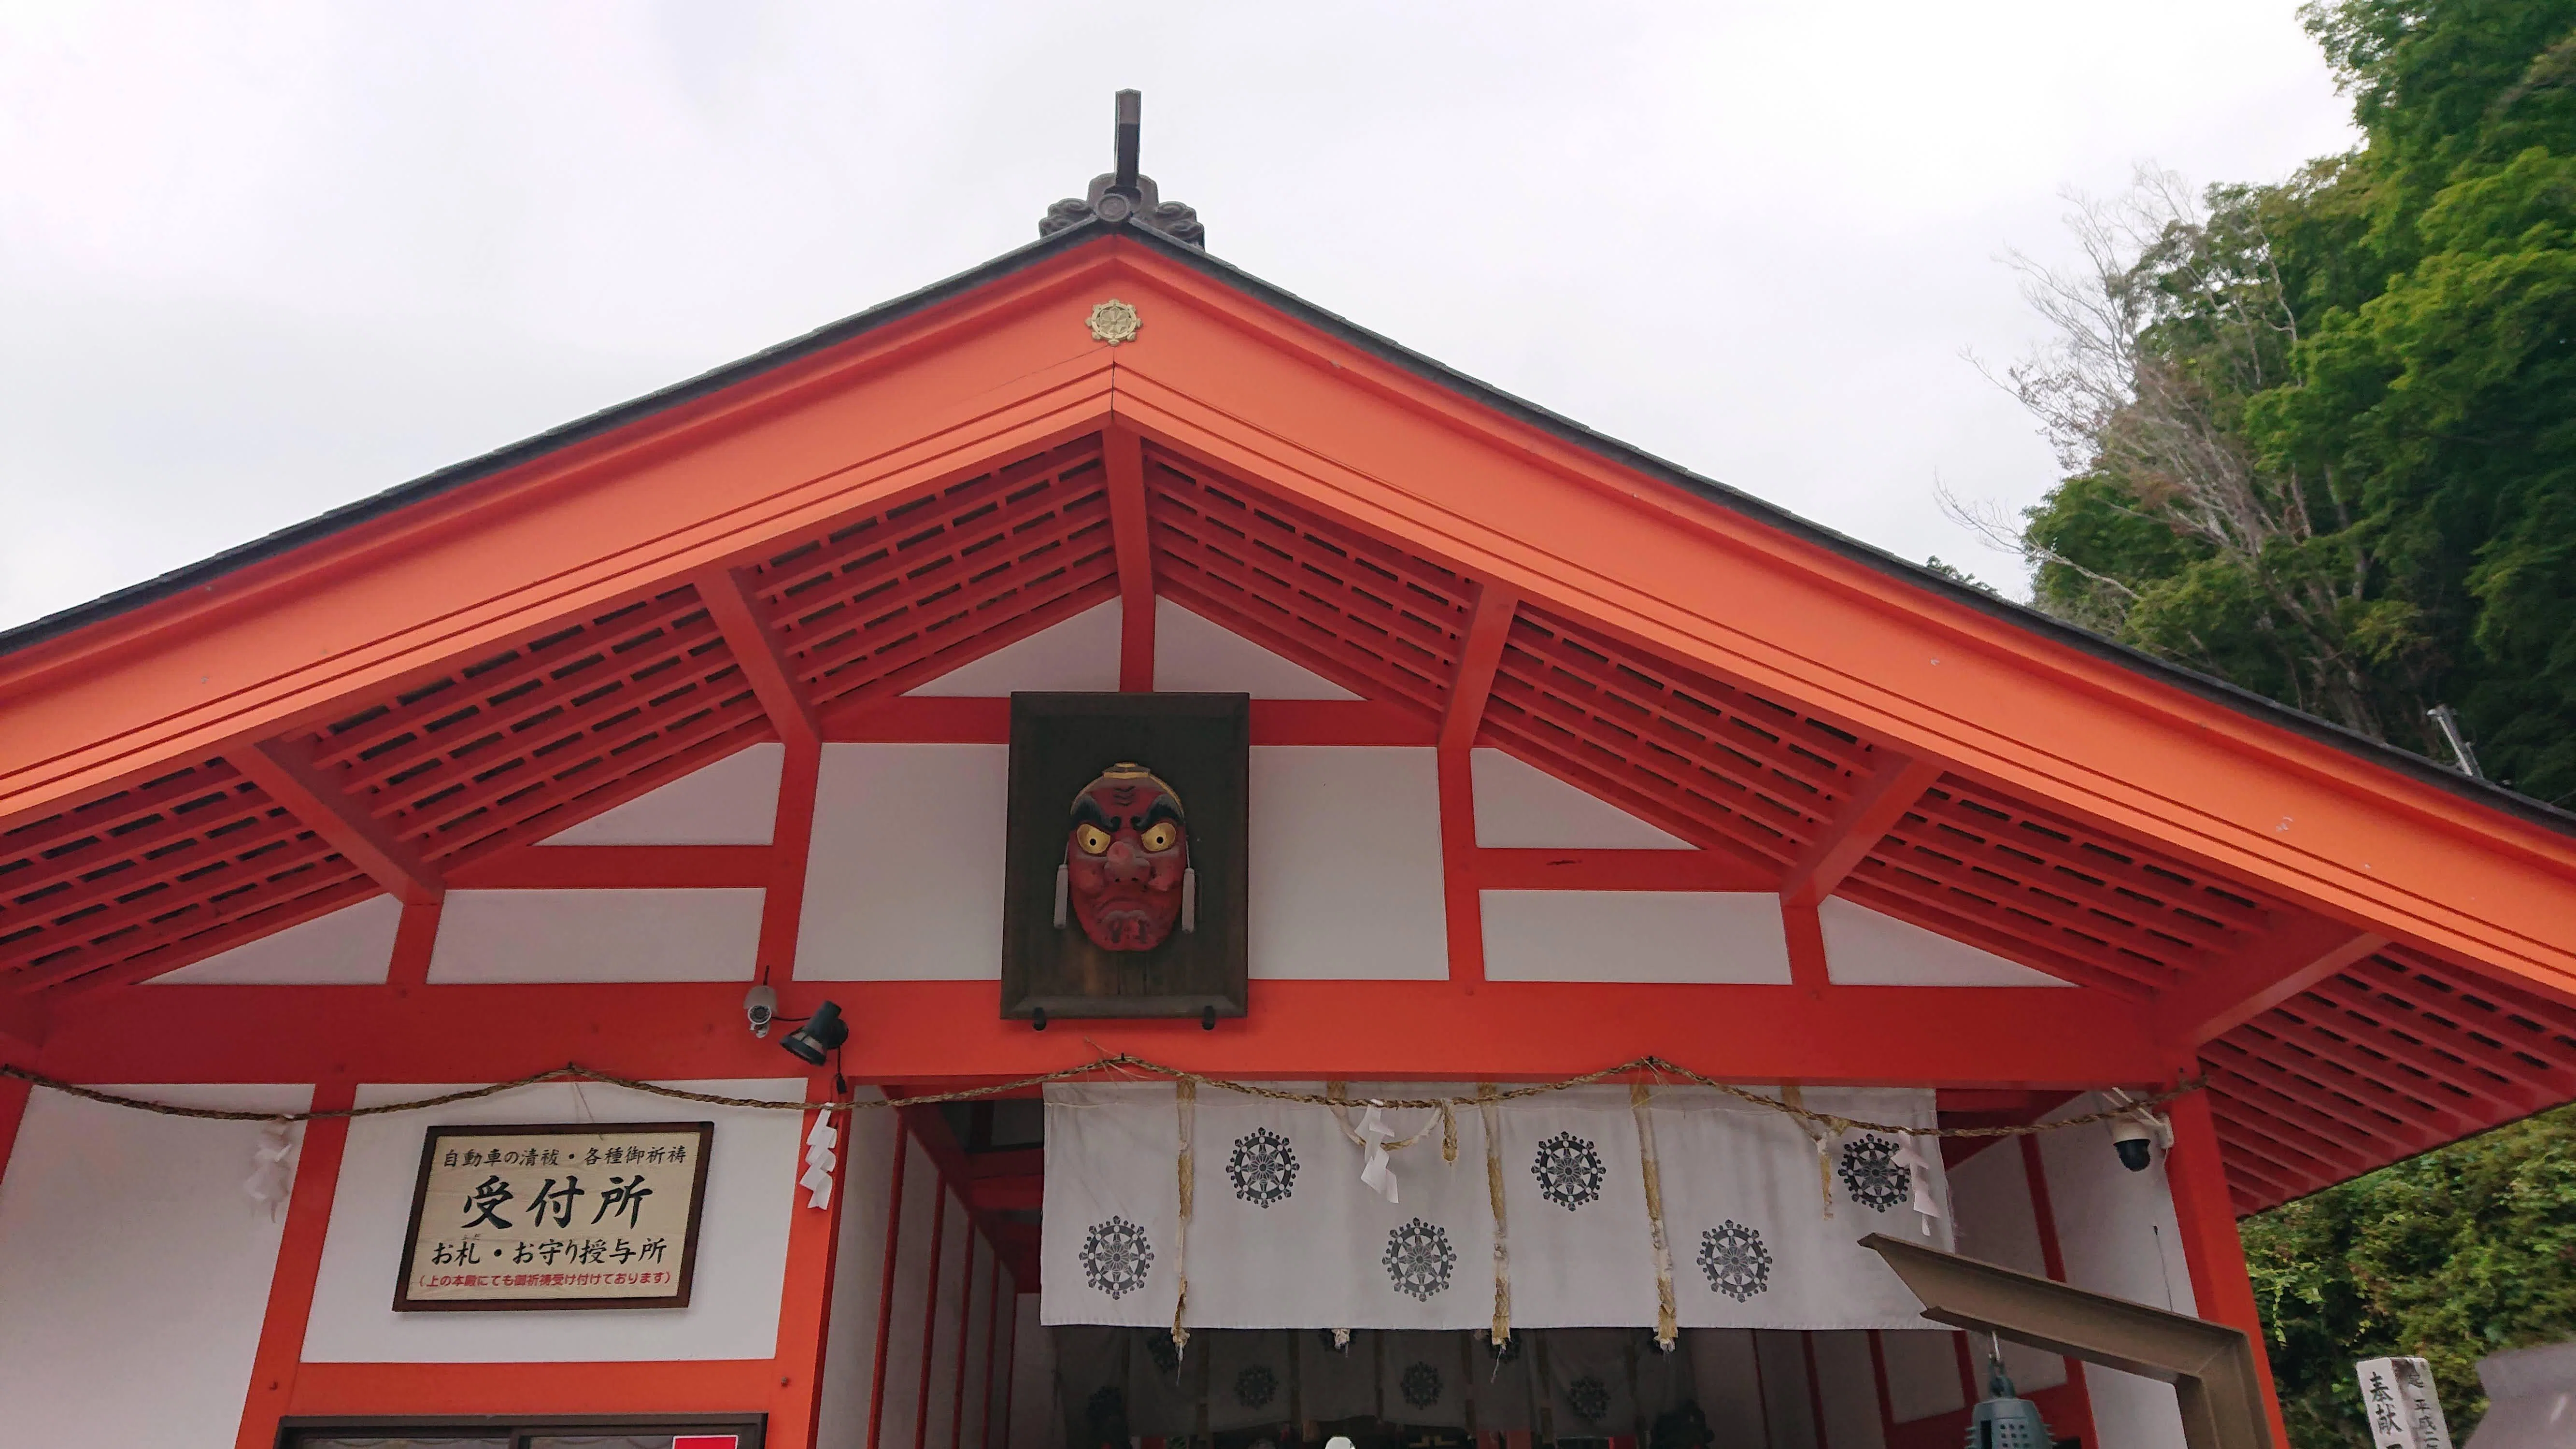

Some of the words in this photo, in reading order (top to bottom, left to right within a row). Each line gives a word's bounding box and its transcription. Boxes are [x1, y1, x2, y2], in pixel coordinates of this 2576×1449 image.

[460, 1175, 653, 1229] 受付所
[432, 1238, 667, 1266] お札・お守り授与所
[2369, 1371, 2404, 1449] 奉献
